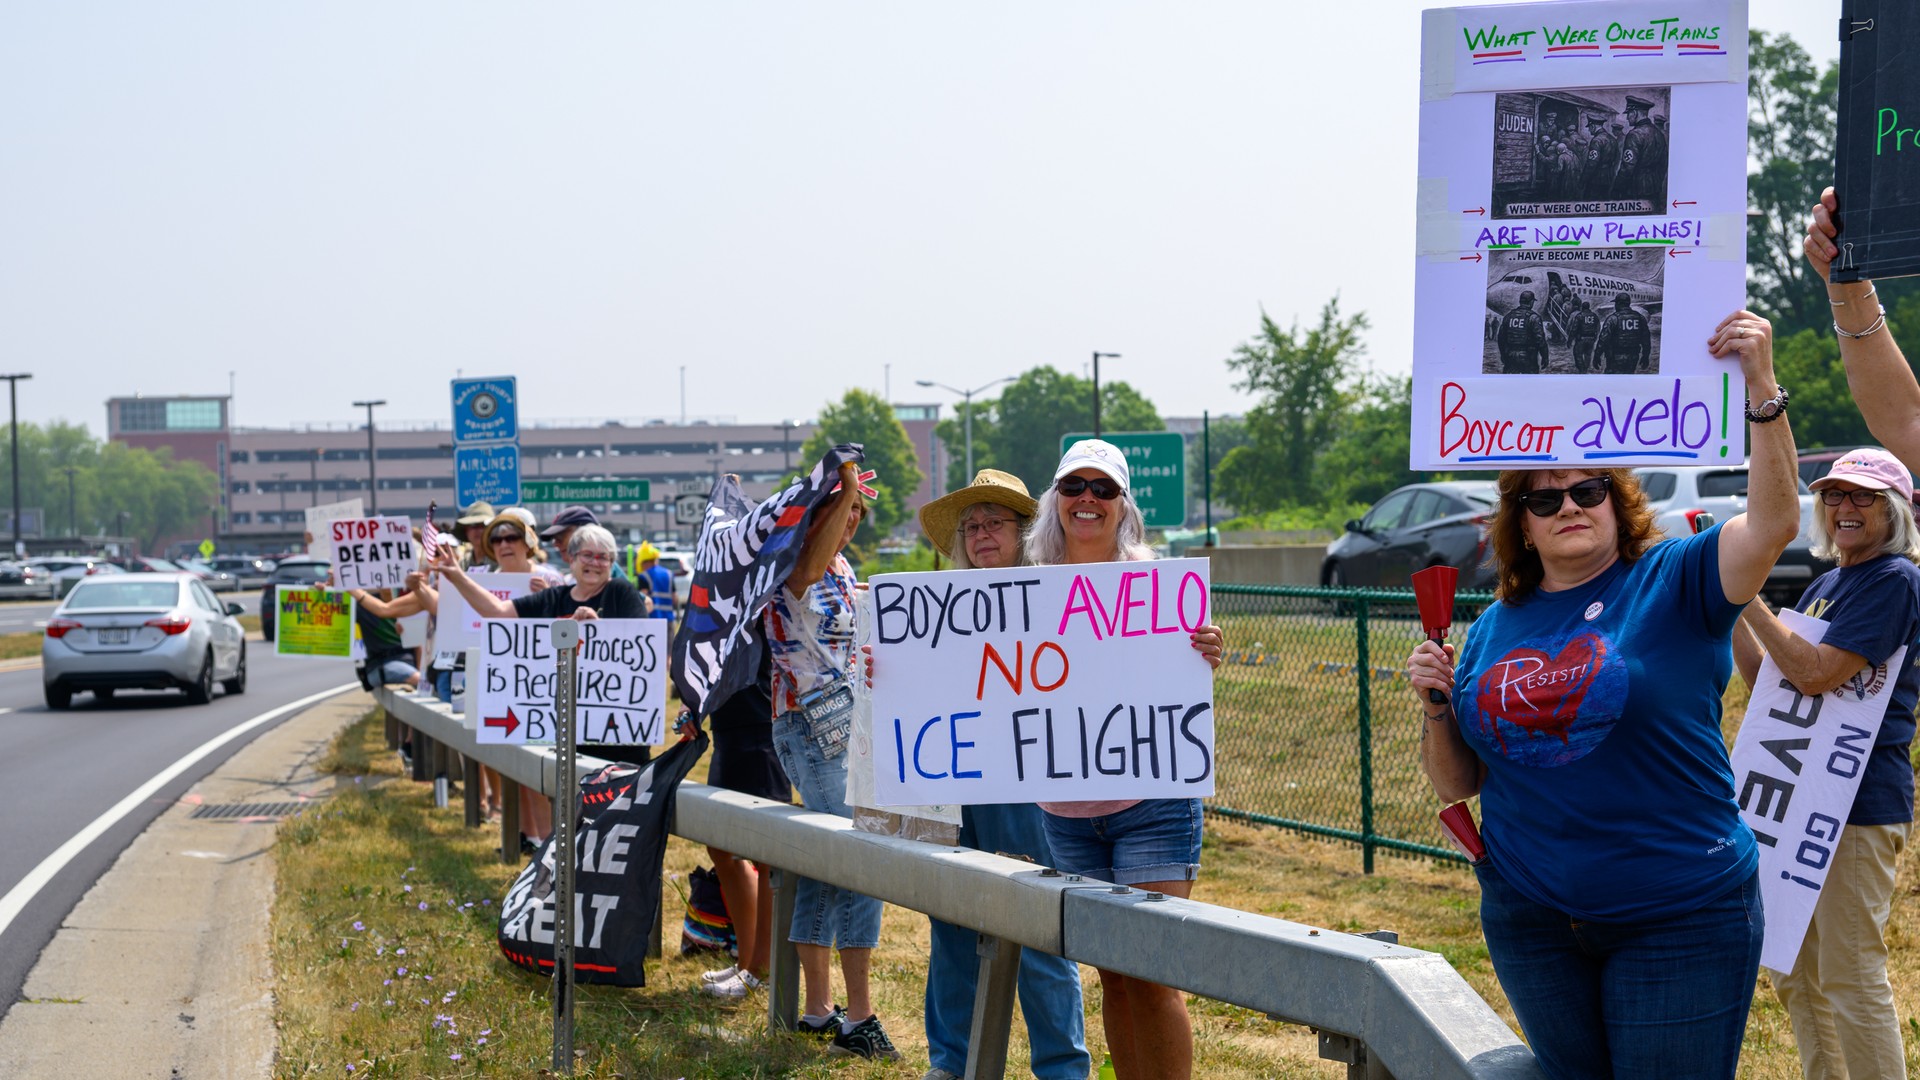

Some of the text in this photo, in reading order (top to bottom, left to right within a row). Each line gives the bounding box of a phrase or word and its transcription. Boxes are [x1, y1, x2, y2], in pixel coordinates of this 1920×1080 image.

[1499, 113, 1533, 133] JUDEN
[1509, 204, 1540, 214] WHAT
[1543, 203, 1571, 214] WERE
[1574, 202, 1600, 212] ONCE
[1475, 221, 1700, 247] ARE NOW PLANES!
[1548, 250, 1589, 260] BECOME
[1593, 250, 1632, 260] PLANES
[1568, 274, 1635, 292] EL SALVADOR
[1509, 318, 1524, 328] ICE
[1585, 315, 1594, 324] ICE
[1622, 319, 1639, 330] ICE
[1121, 446, 1152, 459] any
[460, 456, 514, 472] AIRLINES
[617, 484, 640, 498] Blvd
[332, 520, 380, 541] STOP
[338, 542, 411, 562] DEATH
[288, 590, 343, 602] ALL ARE
[281, 601, 349, 615] WELCOME
[875, 568, 1208, 648] BOYCOTT AVELO
[297, 614, 332, 626] HERE
[488, 622, 550, 660] DUE
[976, 640, 1069, 700] NO
[810, 694, 850, 720] BRUGGE
[526, 709, 557, 740] B
[825, 724, 850, 745] BRUG
[894, 702, 1211, 784] ICE FLIGHTS
[1780, 723, 1872, 891] NO GO!
